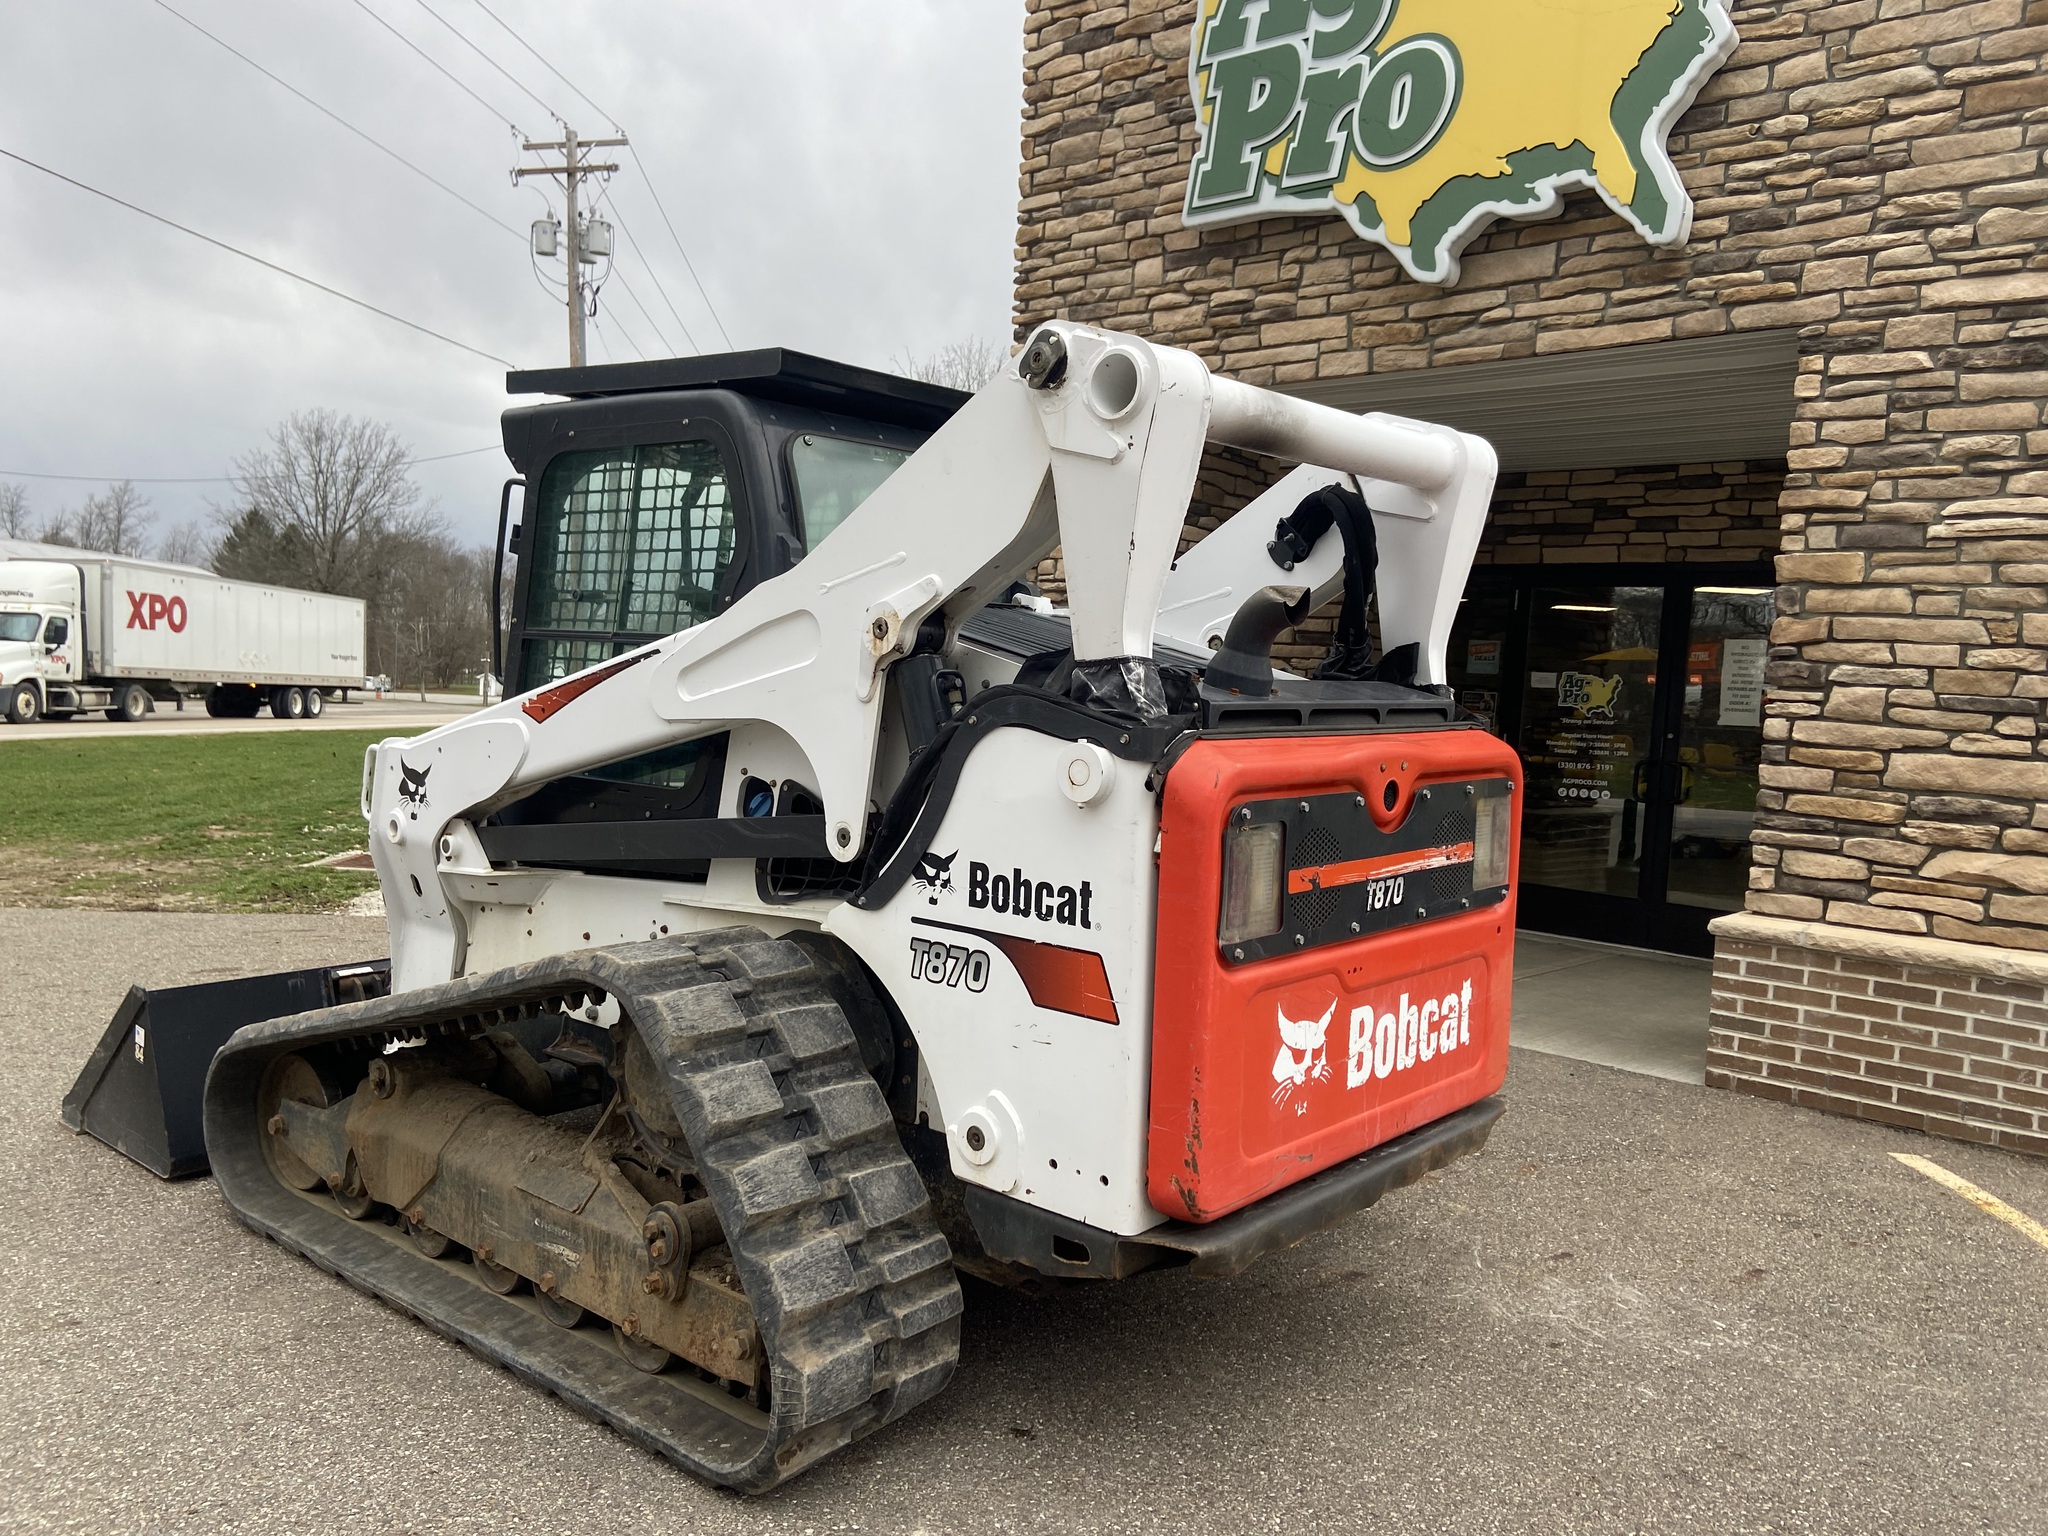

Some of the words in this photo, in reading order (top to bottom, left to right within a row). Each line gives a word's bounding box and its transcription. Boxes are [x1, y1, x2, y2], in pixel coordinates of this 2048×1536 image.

[1193, 41, 1454, 207] Pro
[126, 591, 188, 633] XPO
[50, 655, 66, 664] XPO
[1561, 689, 1591, 704] Pro
[1563, 674, 1591, 692] Ag-
[1557, 761, 1576, 769] (330)
[1577, 762, 1591, 770] 876
[1596, 763, 1614, 771] 3191
[1562, 778, 1608, 786] AGPROCO.COM
[968, 861, 1092, 929] Bobcat
[1366, 877, 1405, 911] T870
[910, 936, 990, 993] T870
[1347, 977, 1473, 1090] Bobcat
